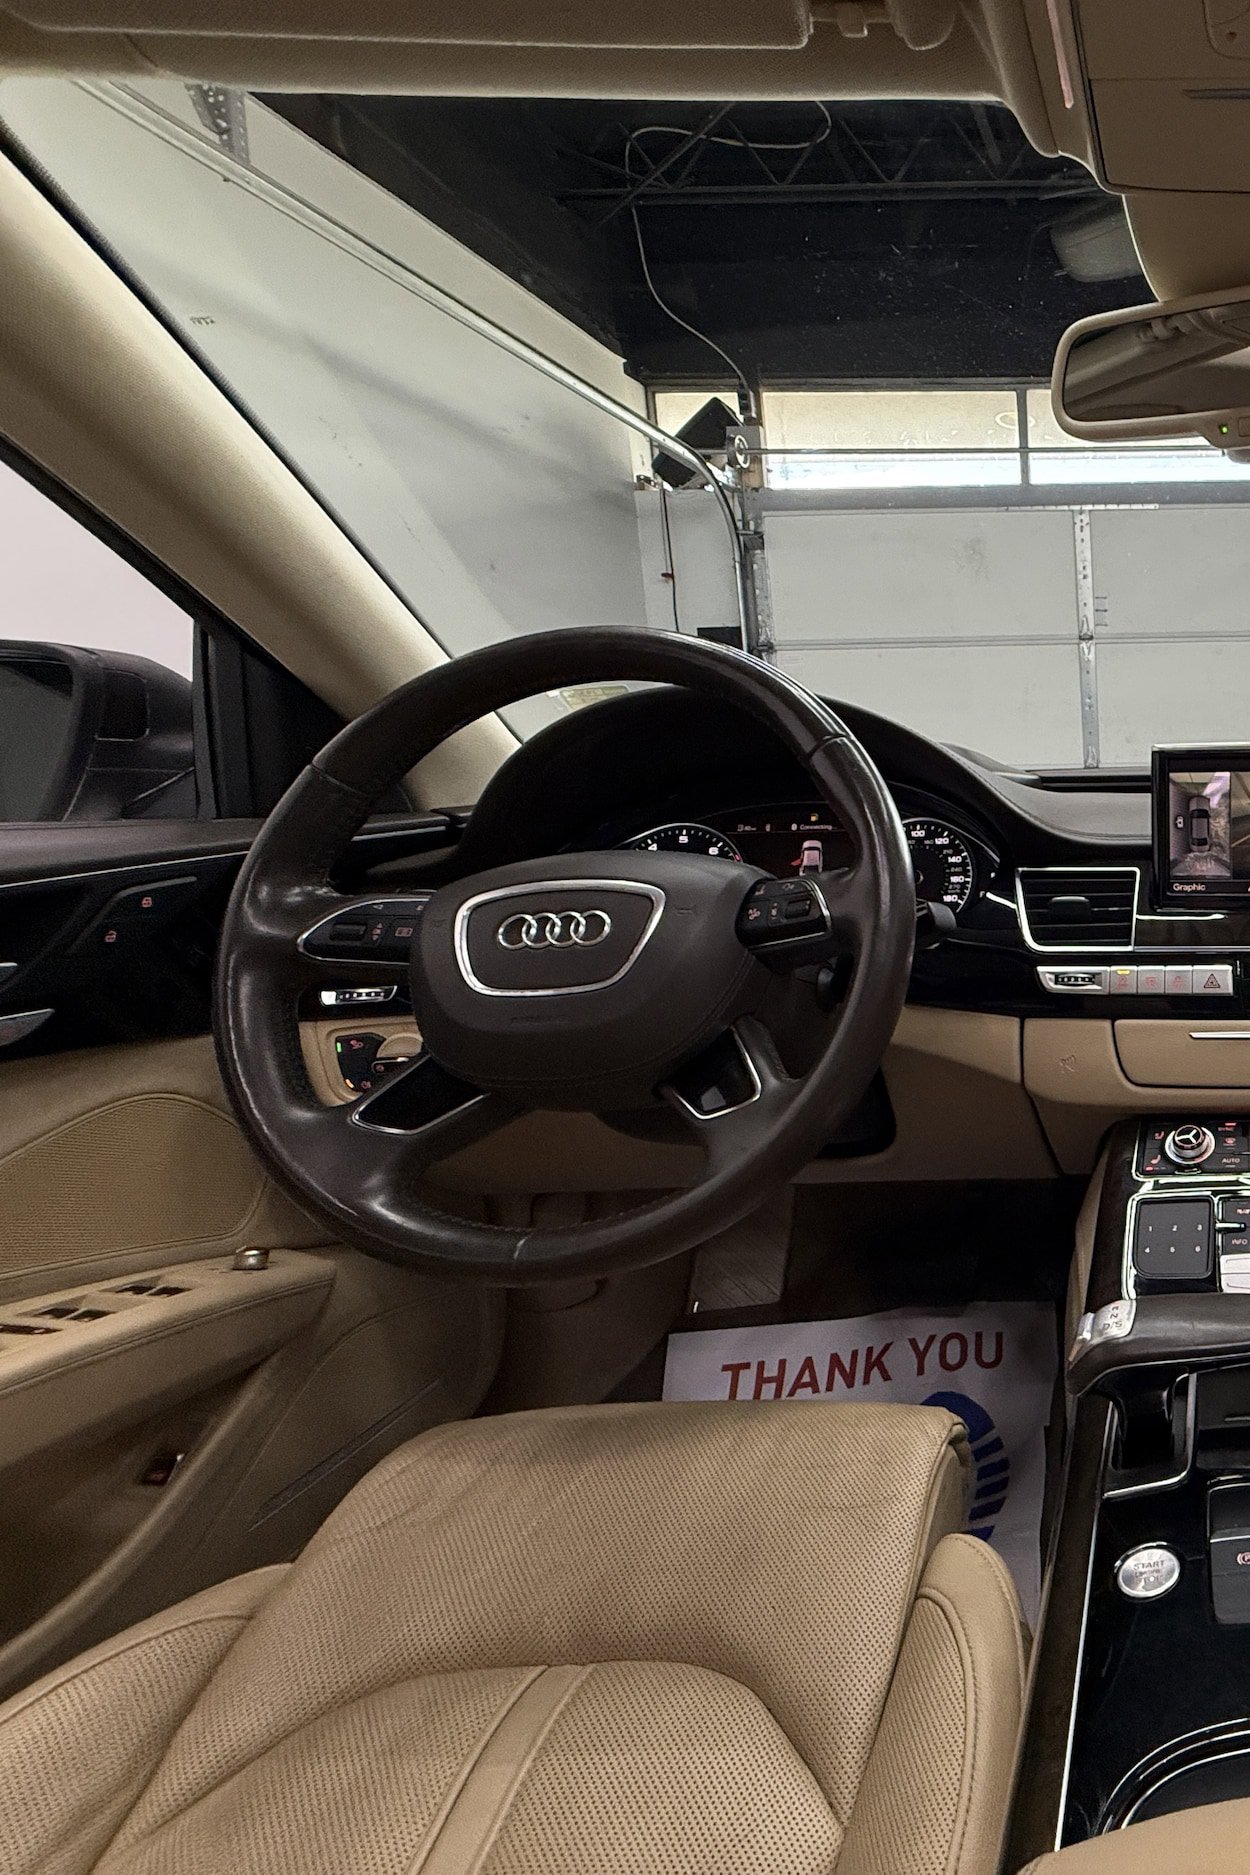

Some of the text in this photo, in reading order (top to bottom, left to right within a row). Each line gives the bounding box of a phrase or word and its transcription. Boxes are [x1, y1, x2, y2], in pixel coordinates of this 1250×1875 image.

[648, 843, 658, 851] 4
[708, 846, 719, 855] 6
[949, 875, 965, 883] 160
[1172, 883, 1206, 892] Graphic
[942, 894, 958, 902] 180
[1231, 1238, 1248, 1246] INFO
[721, 1331, 1004, 1401] THANK YOU
[1134, 1560, 1165, 1570] START
